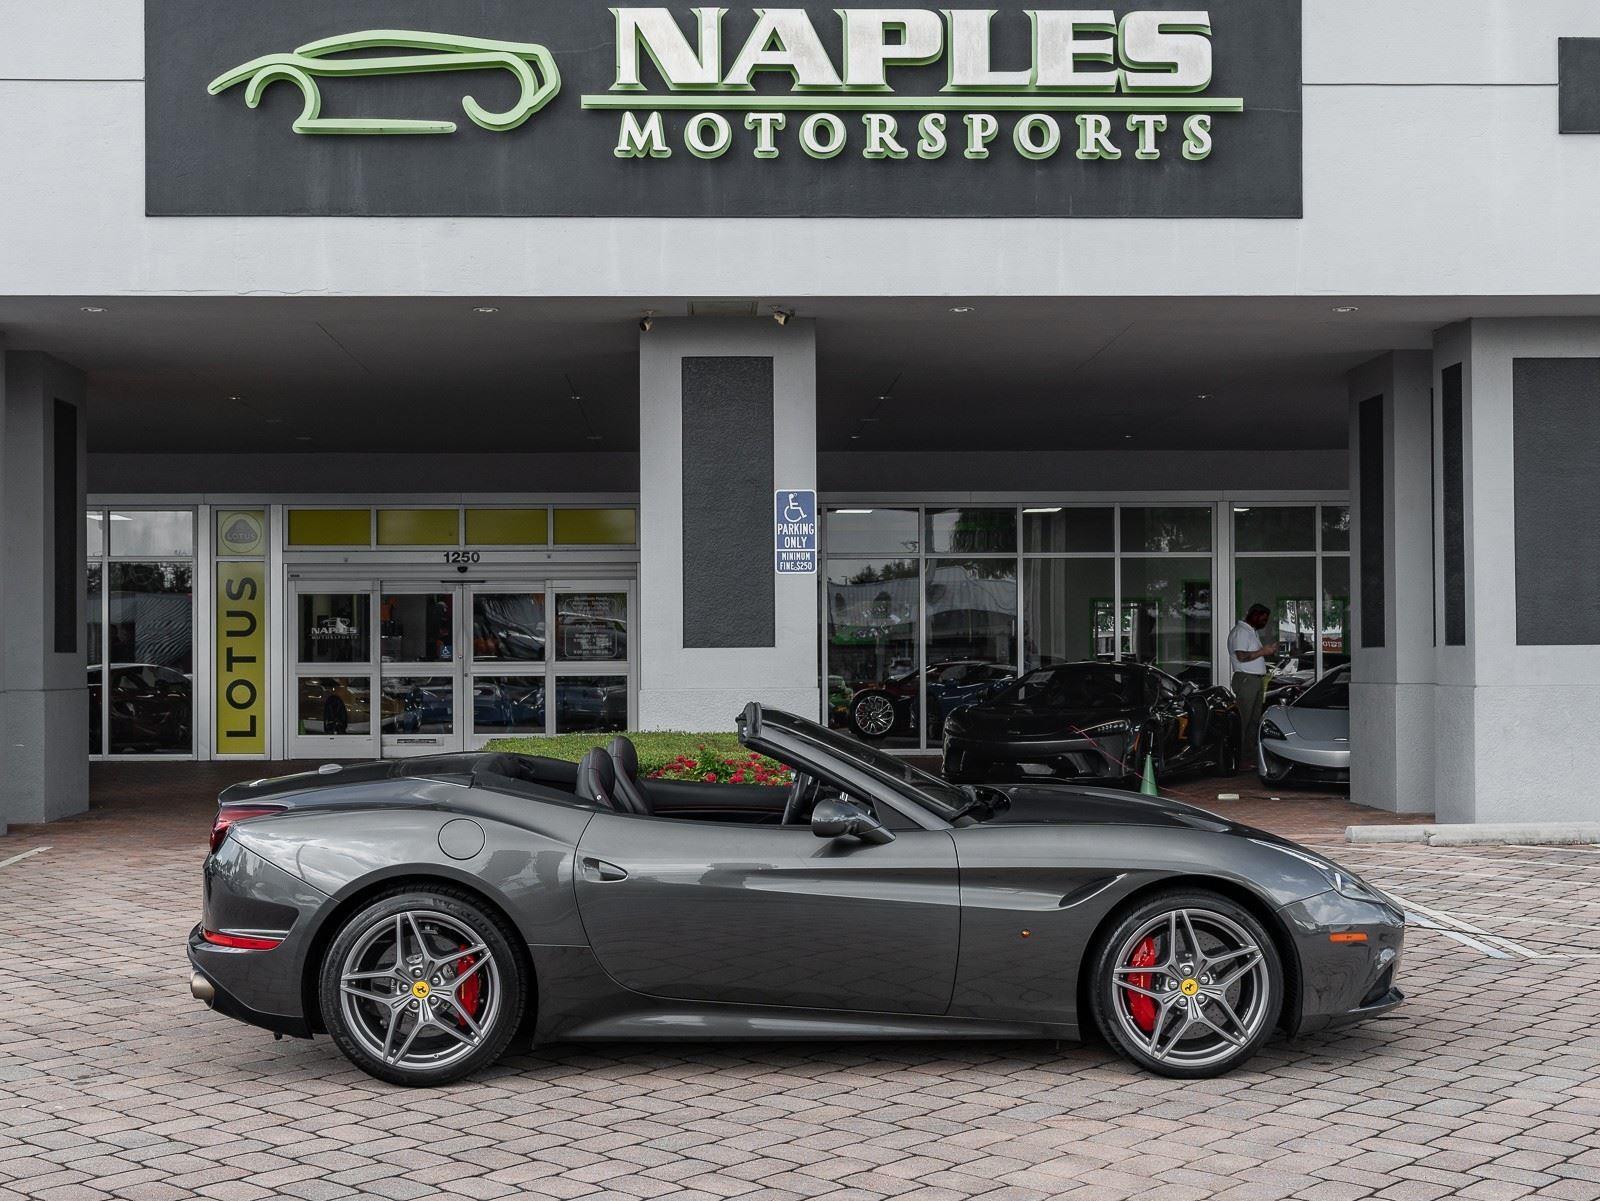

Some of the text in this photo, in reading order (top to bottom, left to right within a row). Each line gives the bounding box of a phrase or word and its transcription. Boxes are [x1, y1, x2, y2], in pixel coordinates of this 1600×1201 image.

[609, 7, 1212, 93] NAPLES
[613, 110, 1212, 160] MOTORSPORTS
[778, 523, 814, 535] PARKING
[784, 537, 807, 548] ONLY
[443, 551, 481, 563] 1250
[782, 552, 810, 561] MINIMUM
[780, 561, 812, 571] FINE $250
[226, 576, 258, 738] LOTUS
